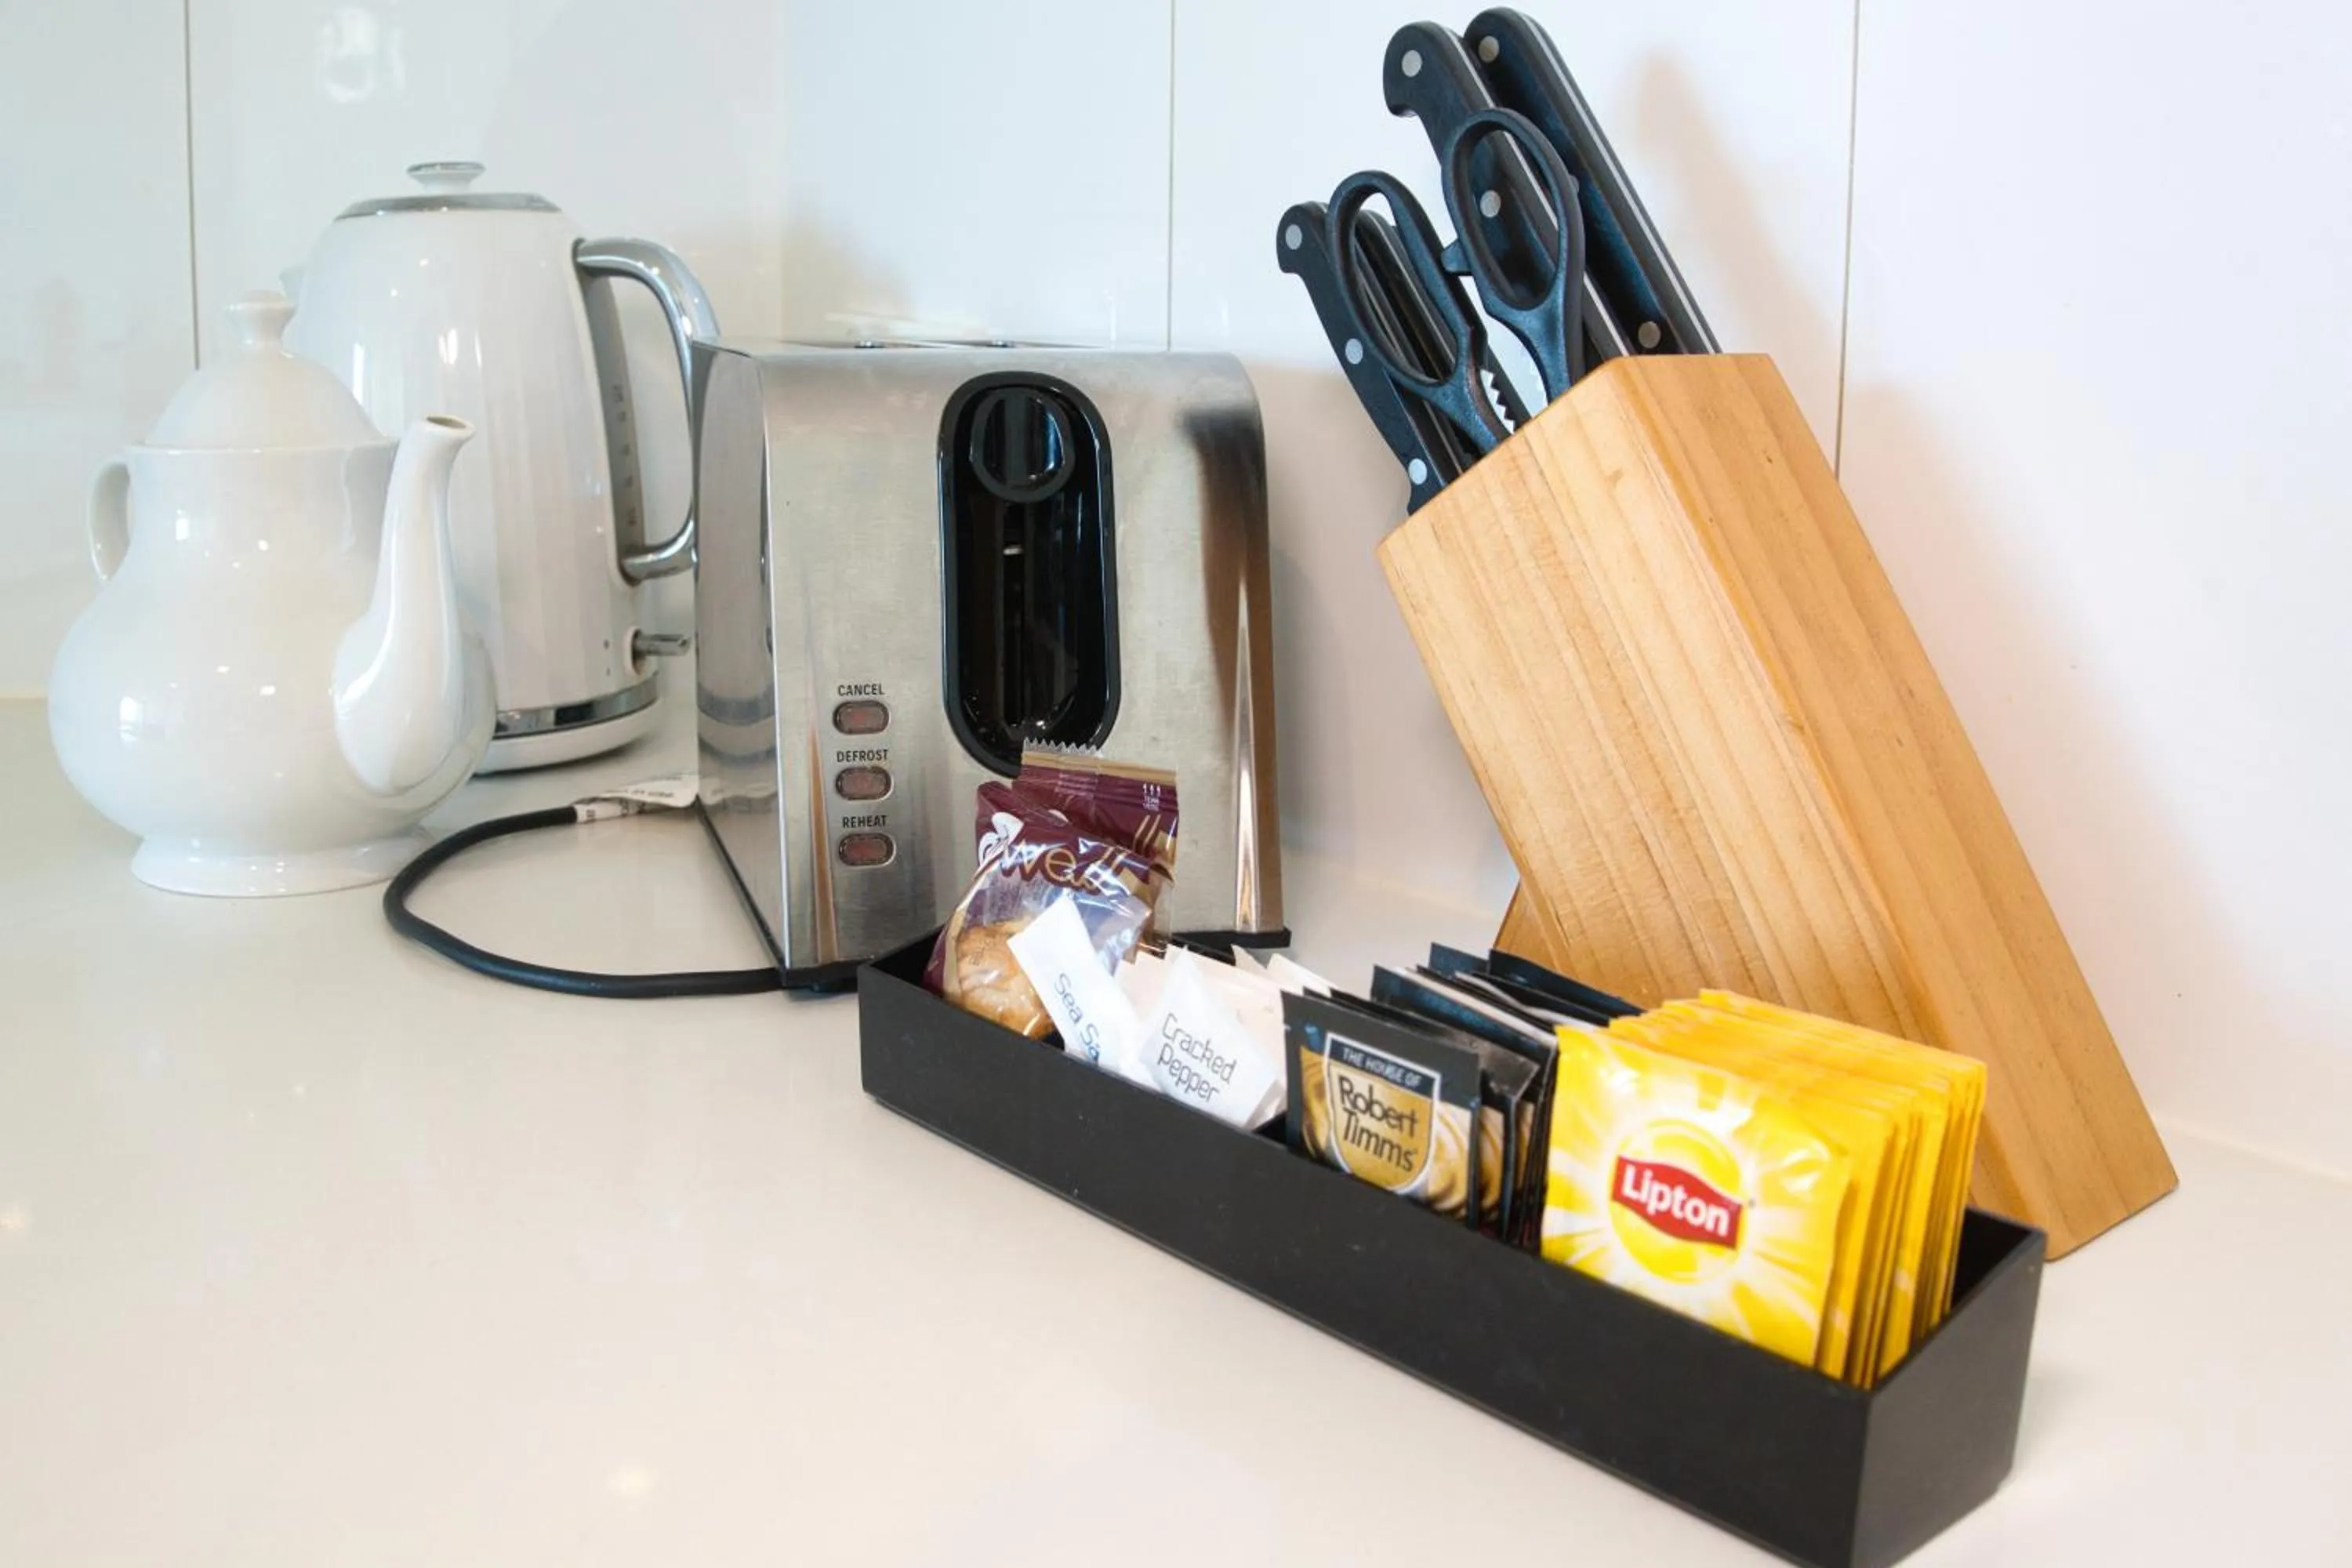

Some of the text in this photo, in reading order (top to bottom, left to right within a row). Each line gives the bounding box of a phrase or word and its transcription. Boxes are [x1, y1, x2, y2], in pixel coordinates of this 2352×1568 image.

[837, 683, 885, 696] CANCEL
[837, 750, 888, 763] DEFROST
[842, 815, 887, 829] REHEAT
[1054, 972, 1101, 1061] Sea Sa
[1157, 1043, 1220, 1102] Pepper
[1162, 1011, 1237, 1084] Cracked
[1343, 1047, 1422, 1087] THE HOUSE OF
[1338, 1075, 1417, 1138] Robert
[1341, 1106, 1414, 1171] Timms
[1621, 1163, 1730, 1237] Lipton
